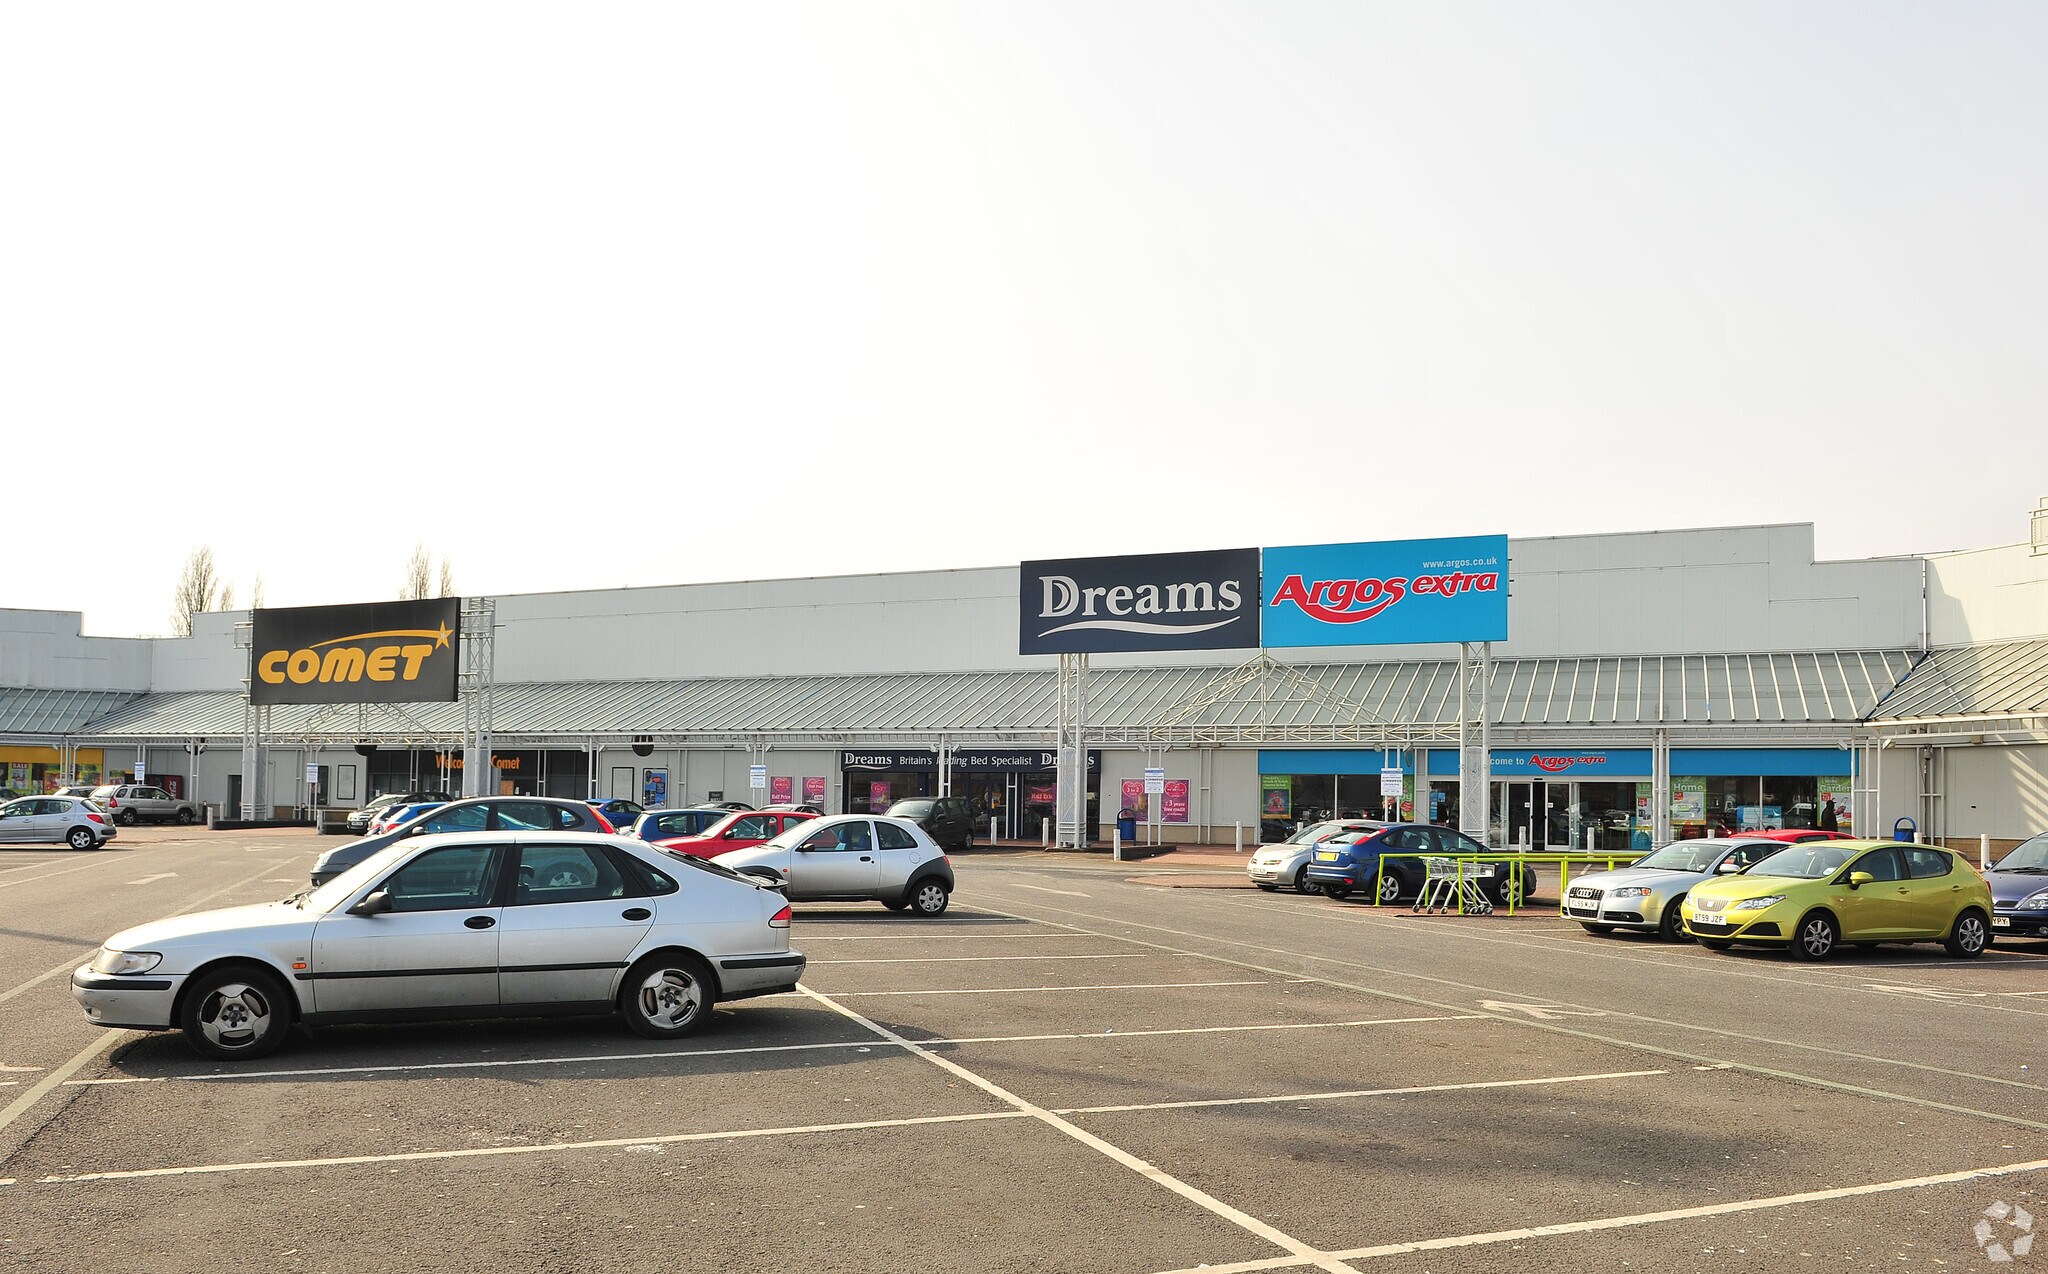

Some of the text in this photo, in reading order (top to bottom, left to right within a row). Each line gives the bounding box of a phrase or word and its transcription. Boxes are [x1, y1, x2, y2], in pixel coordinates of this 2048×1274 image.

[1422, 556, 1498, 569] www.argos.co.uk
[1038, 575, 1242, 618] Dreams
[1270, 571, 1499, 624] Argos extra
[258, 644, 433, 684] COMET
[490, 755, 520, 769] Comet
[844, 752, 893, 765] Dreams
[899, 756, 933, 765] Britain's
[970, 756, 988, 765] Bed
[991, 755, 1032, 767] Specialist
[1516, 757, 1525, 766] to
[1528, 754, 1575, 773] Argos
[1576, 756, 1606, 765] extra
[1673, 783, 1704, 792] Home
